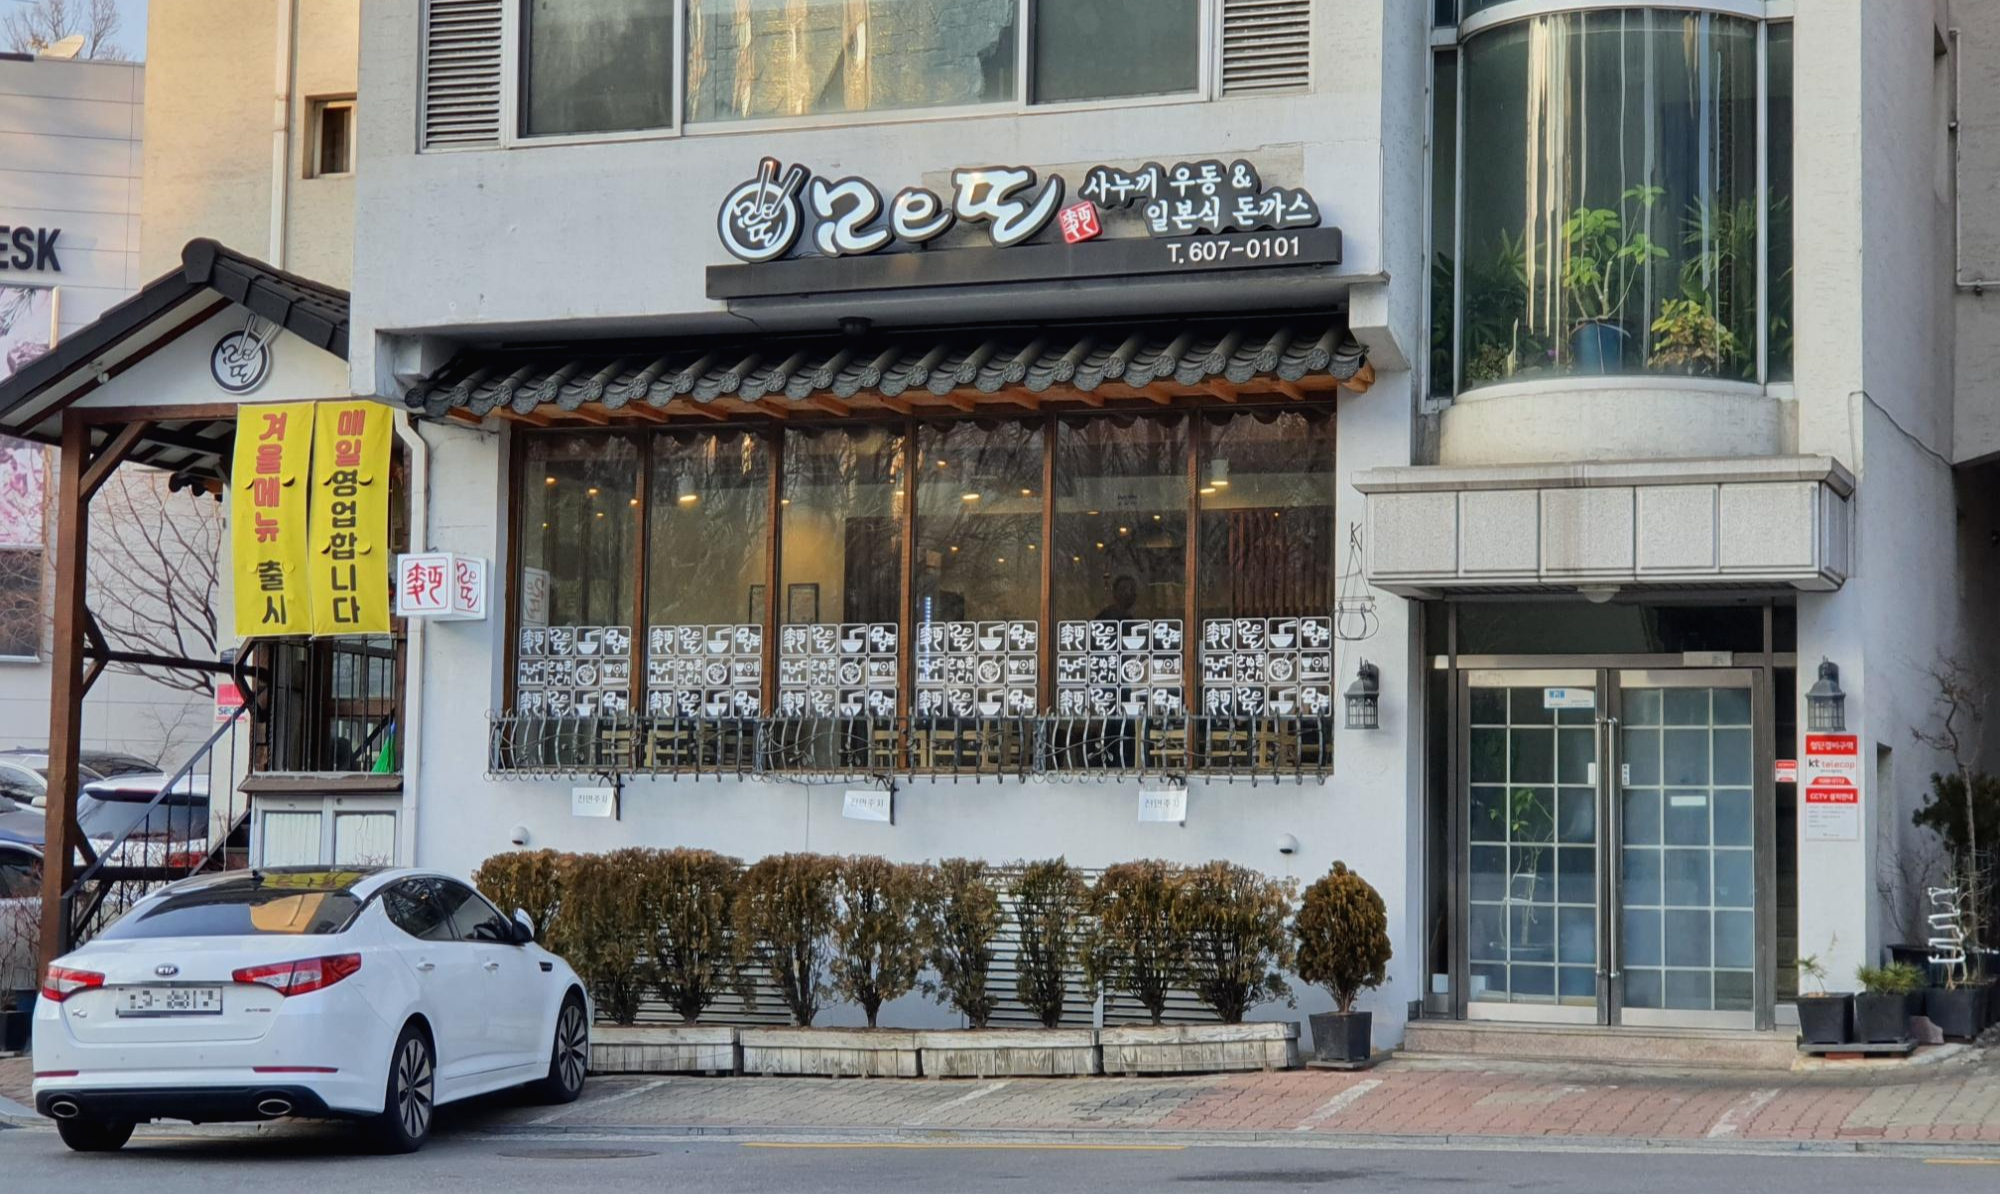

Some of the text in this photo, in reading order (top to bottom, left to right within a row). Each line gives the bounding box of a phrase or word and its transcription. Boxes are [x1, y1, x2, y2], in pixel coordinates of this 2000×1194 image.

[1084, 164, 1252, 203] 사누끼 우동 &
[1147, 192, 1312, 232] 일본식 돈까스
[1808, 758, 1855, 769] kt telecop
